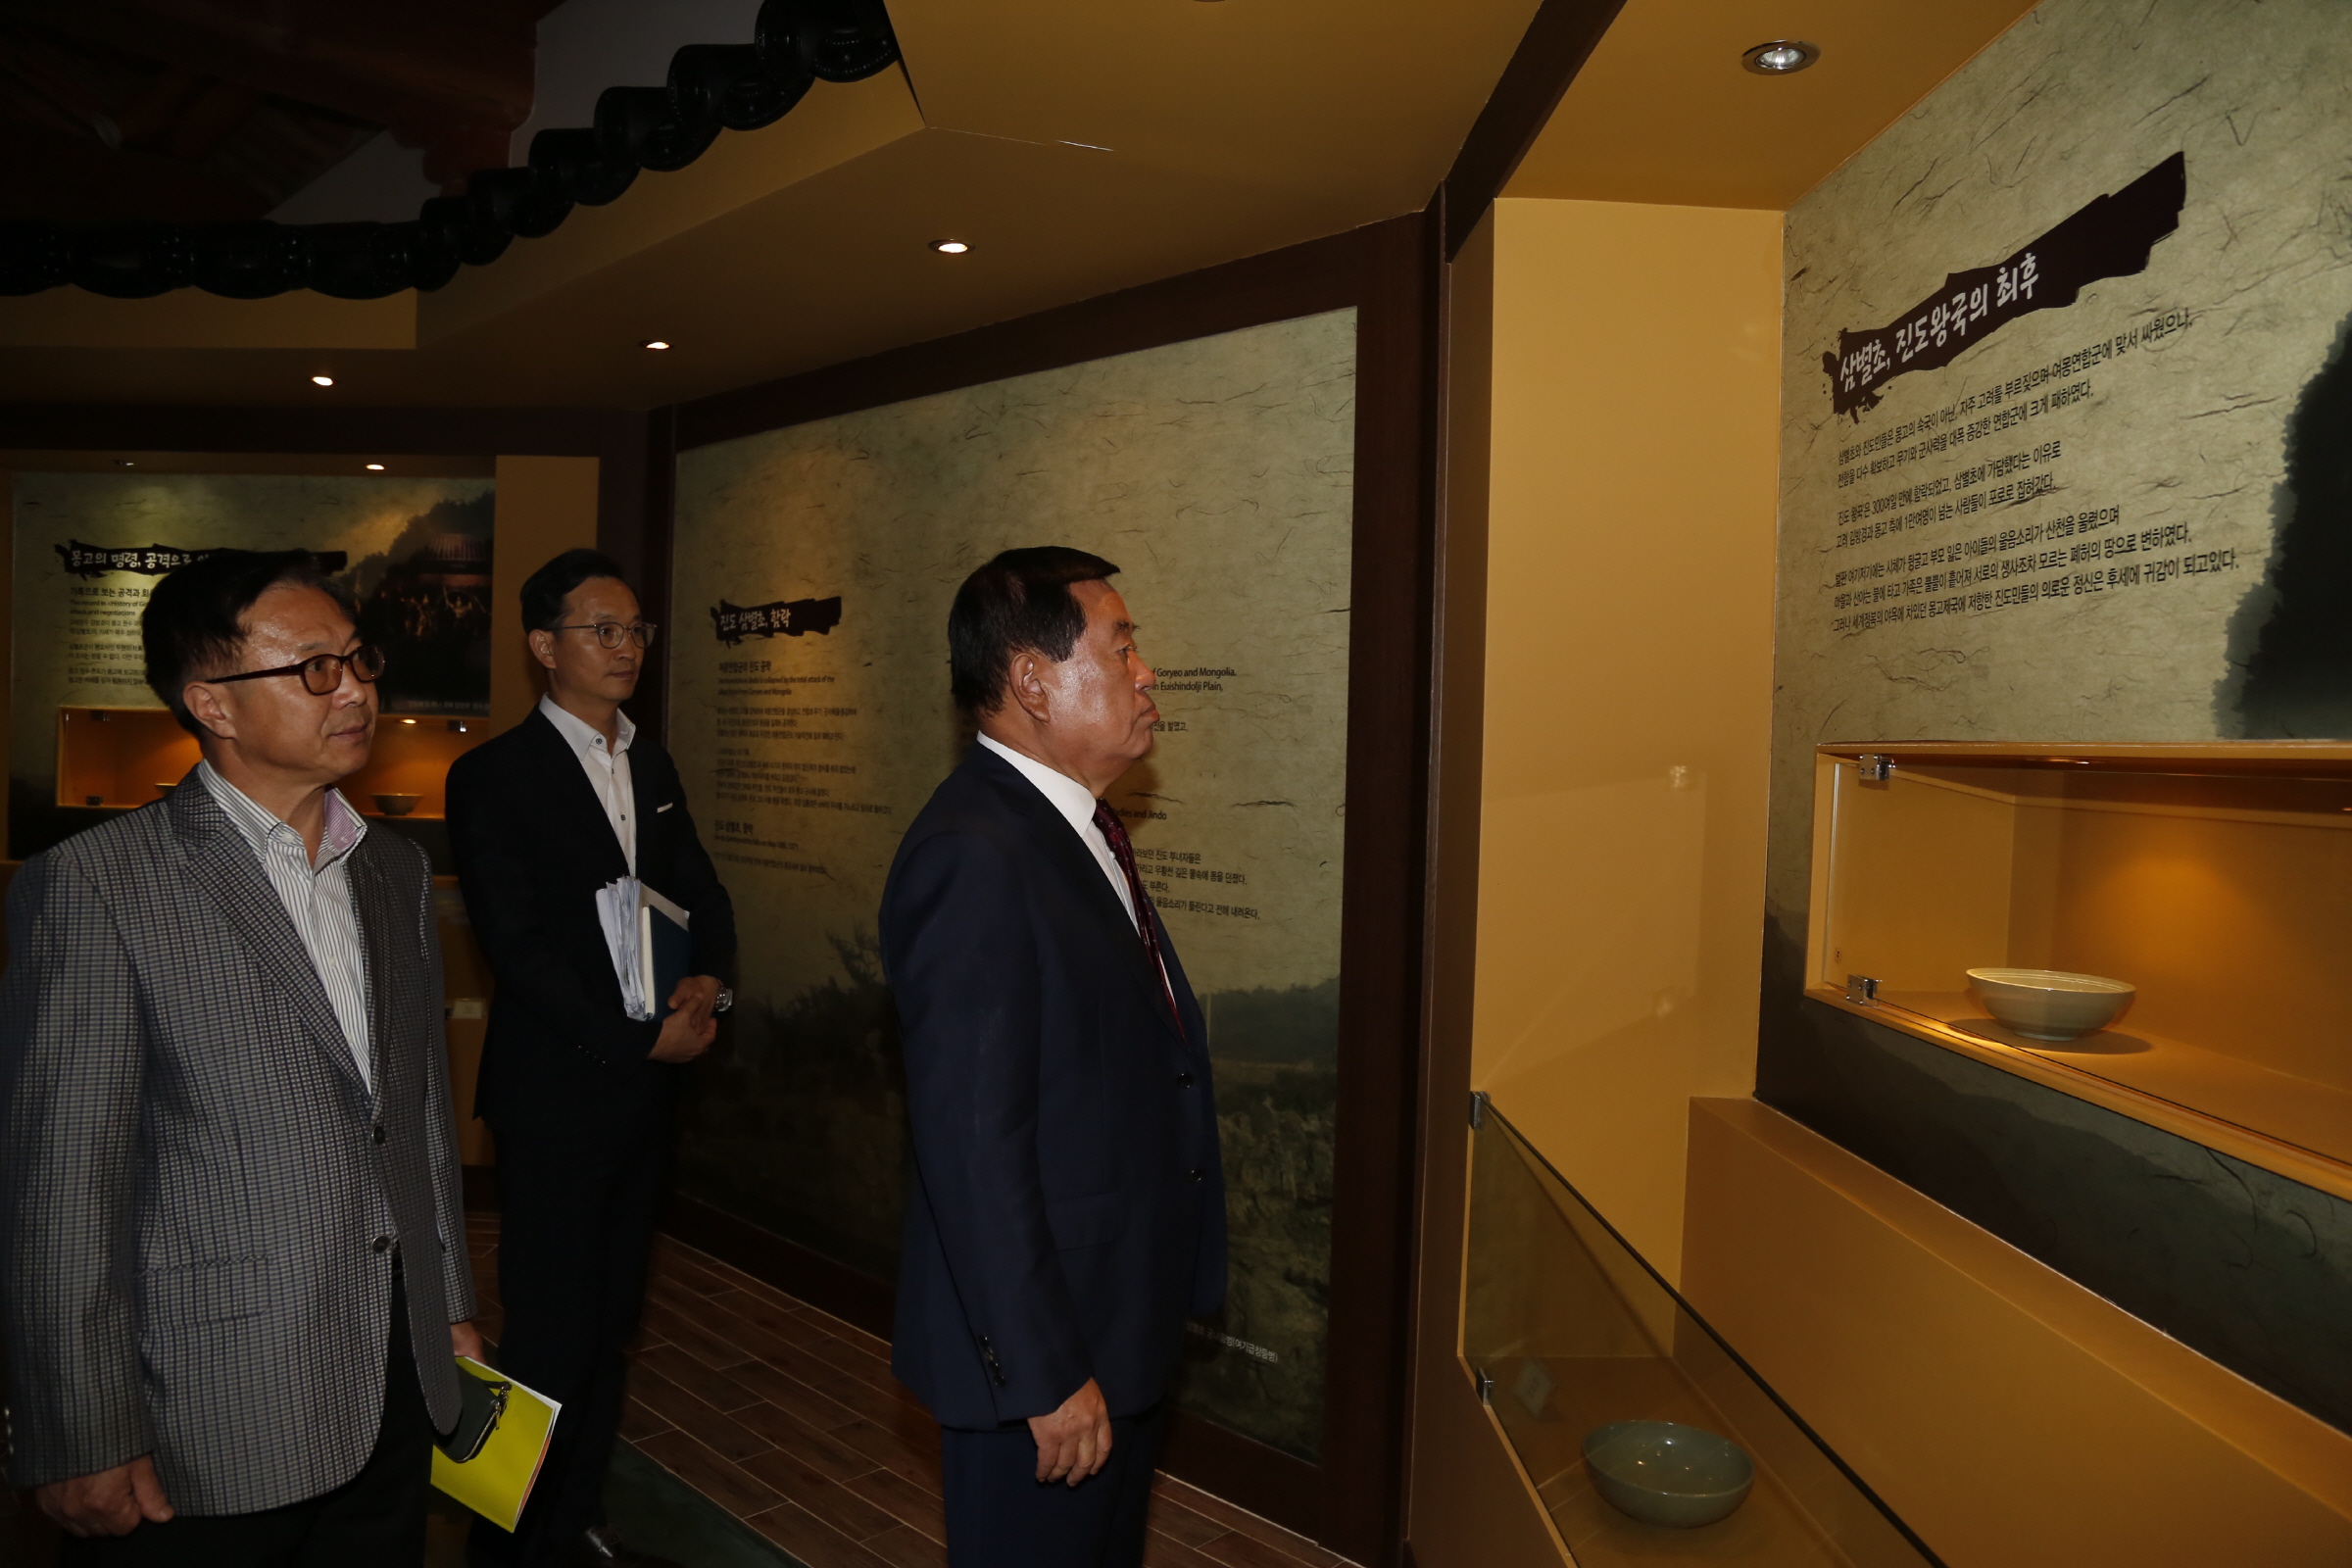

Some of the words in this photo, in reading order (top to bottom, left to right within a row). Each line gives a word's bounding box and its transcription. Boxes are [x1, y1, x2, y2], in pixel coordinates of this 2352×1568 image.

[1840, 339, 1890, 392] 삼별초,
[1895, 283, 1987, 363] 진도왕국의
[1996, 252, 2039, 308] 최후
[1838, 442, 1862, 466] 삼별초와
[1863, 427, 1893, 457] 진도민들은
[1895, 420, 1915, 443] 몽고의
[1917, 410, 1938, 433] 속국이
[1960, 396, 1976, 416] 자주
[1978, 384, 2003, 410] 고려를
[2005, 365, 2048, 400] 부르짖으며
[2052, 338, 2113, 379] 여몽연합군에
[2116, 327, 2138, 357] 맞서
[1838, 468, 1855, 488] 전함을
[1856, 465, 1869, 480] 다수
[1870, 455, 1895, 476] 확보하고
[1897, 445, 1917, 467] 무기와
[1919, 433, 1948, 460] 군사력을
[1950, 427, 1965, 447] 대폭
[1966, 416, 1991, 442] 증강한
[1993, 402, 2027, 432] 연합군에
[2030, 394, 2048, 414] 크게
[2051, 378, 2093, 410] 패하였다.
[1872, 492, 1897, 515] 300여일
[1899, 488, 1913, 508] 만에
[1914, 477, 1952, 503] 함락되었고,
[1954, 465, 1985, 490] 삼별초에
[1987, 451, 2032, 478] 가담했다는
[2033, 440, 2062, 465] 이유로
[1837, 531, 1848, 549] 고려
[1850, 523, 1874, 546] 김방경과
[1875, 521, 1887, 539] 몽고
[1888, 515, 1902, 534] 측에
[1905, 506, 1936, 529] 1만여명이
[1938, 502, 1953, 521] 넘는
[1955, 490, 1986, 515] 사람들이
[1988, 484, 2015, 506] 포로로
[1848, 563, 1885, 584] 여기저기에는
[1886, 555, 1906, 575] 시체가
[1907, 552, 1929, 571] 뒹굴고
[1931, 547, 1945, 566] 부모
[1947, 543, 1962, 563] 잃은
[1964, 533, 1997, 559] 아이들의
[1999, 523, 2043, 551] 울음소리가
[2046, 515, 2076, 541] 산천을
[2078, 504, 2120, 533] 울렸으며
[71, 550, 107, 566] 몽고의
[111, 552, 141, 568] 명령,
[145, 553, 192, 568] 공격으로
[1835, 592, 1852, 610] 마을과
[1873, 584, 1886, 603] 불에
[1887, 582, 1900, 599] 타고
[1902, 576, 1923, 597] 가족은
[1925, 572, 1947, 593] 뿔뿔이
[1948, 566, 1972, 588] 흩어져
[1974, 561, 1999, 583] 서로의
[2001, 553, 2036, 578] 생사조차
[2038, 549, 2068, 569] 모르는
[2071, 539, 2101, 564] 폐허의
[2105, 533, 2136, 559] 땅으로
[2140, 521, 2191, 552] 변하였다.
[71, 587, 99, 596] 기록으로
[101, 588, 116, 598] 보는
[118, 588, 140, 598] 공격과
[142, 588, 152, 598] 회
[1833, 615, 1851, 632] 그러나
[1852, 610, 1884, 629] 세계정복의
[1885, 606, 1904, 623] 야욕에
[1905, 602, 1927, 621] 차있던
[1929, 595, 1966, 618] 몽고제국에
[1968, 591, 1992, 611] 저항한
[1995, 582, 2038, 608] 진도민들의
[2040, 576, 2070, 599] 의로운
[2073, 570, 2105, 596] 정신은
[2107, 564, 2140, 590] 후세에
[2144, 557, 2180, 583] 귀감이
[2183, 547, 2239, 576] 되고있다.
[719, 612, 736, 631] 진도
[739, 610, 768, 631] 삼별초,
[770, 608, 791, 628] 함락
[1156, 668, 1183, 679] Goryeo
[1184, 667, 1198, 677] and
[1200, 666, 1237, 679] Mongolia.
[1160, 681, 1201, 693] Euishindolji
[1203, 681, 1223, 692] Plain,
[1152, 720, 1165, 731] 전을
[1115, 808, 1132, 817] adies
[1134, 809, 1147, 818] and
[1148, 810, 1167, 819] Jindo
[1155, 851, 1168, 860] 진도
[1169, 851, 1201, 864] 부녀자들은
[1189, 869, 1209, 881] 물속에
[1209, 870, 1224, 882] 몸을
[1225, 873, 1248, 886] 던졌다.
[1156, 897, 1188, 910] 울음소리가
[1189, 901, 1214, 913] 들린다고
[1215, 904, 1229, 915] 전해
[1231, 906, 1260, 920] 내려온다.
